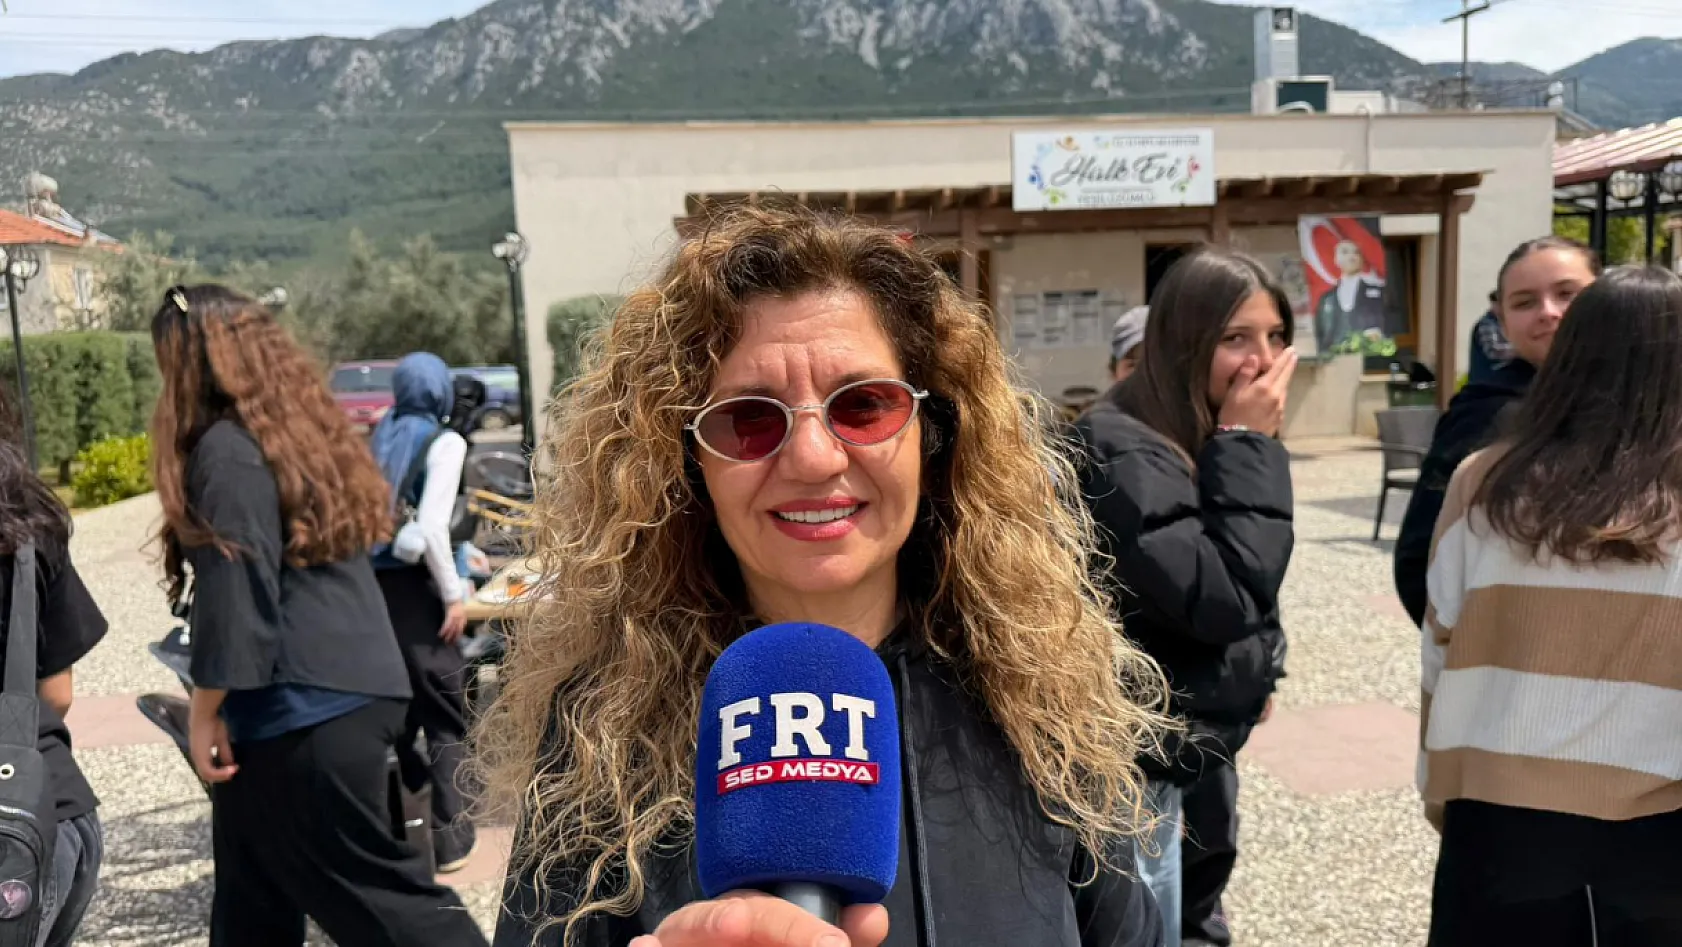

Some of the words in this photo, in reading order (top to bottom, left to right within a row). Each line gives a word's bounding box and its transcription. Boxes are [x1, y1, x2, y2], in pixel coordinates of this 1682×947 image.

[1051, 152, 1128, 186] Halk
[1133, 152, 1180, 184] Evi
[718, 692, 876, 770] FRT
[725, 765, 773, 789] SED
[781, 761, 873, 781] MEDYA
